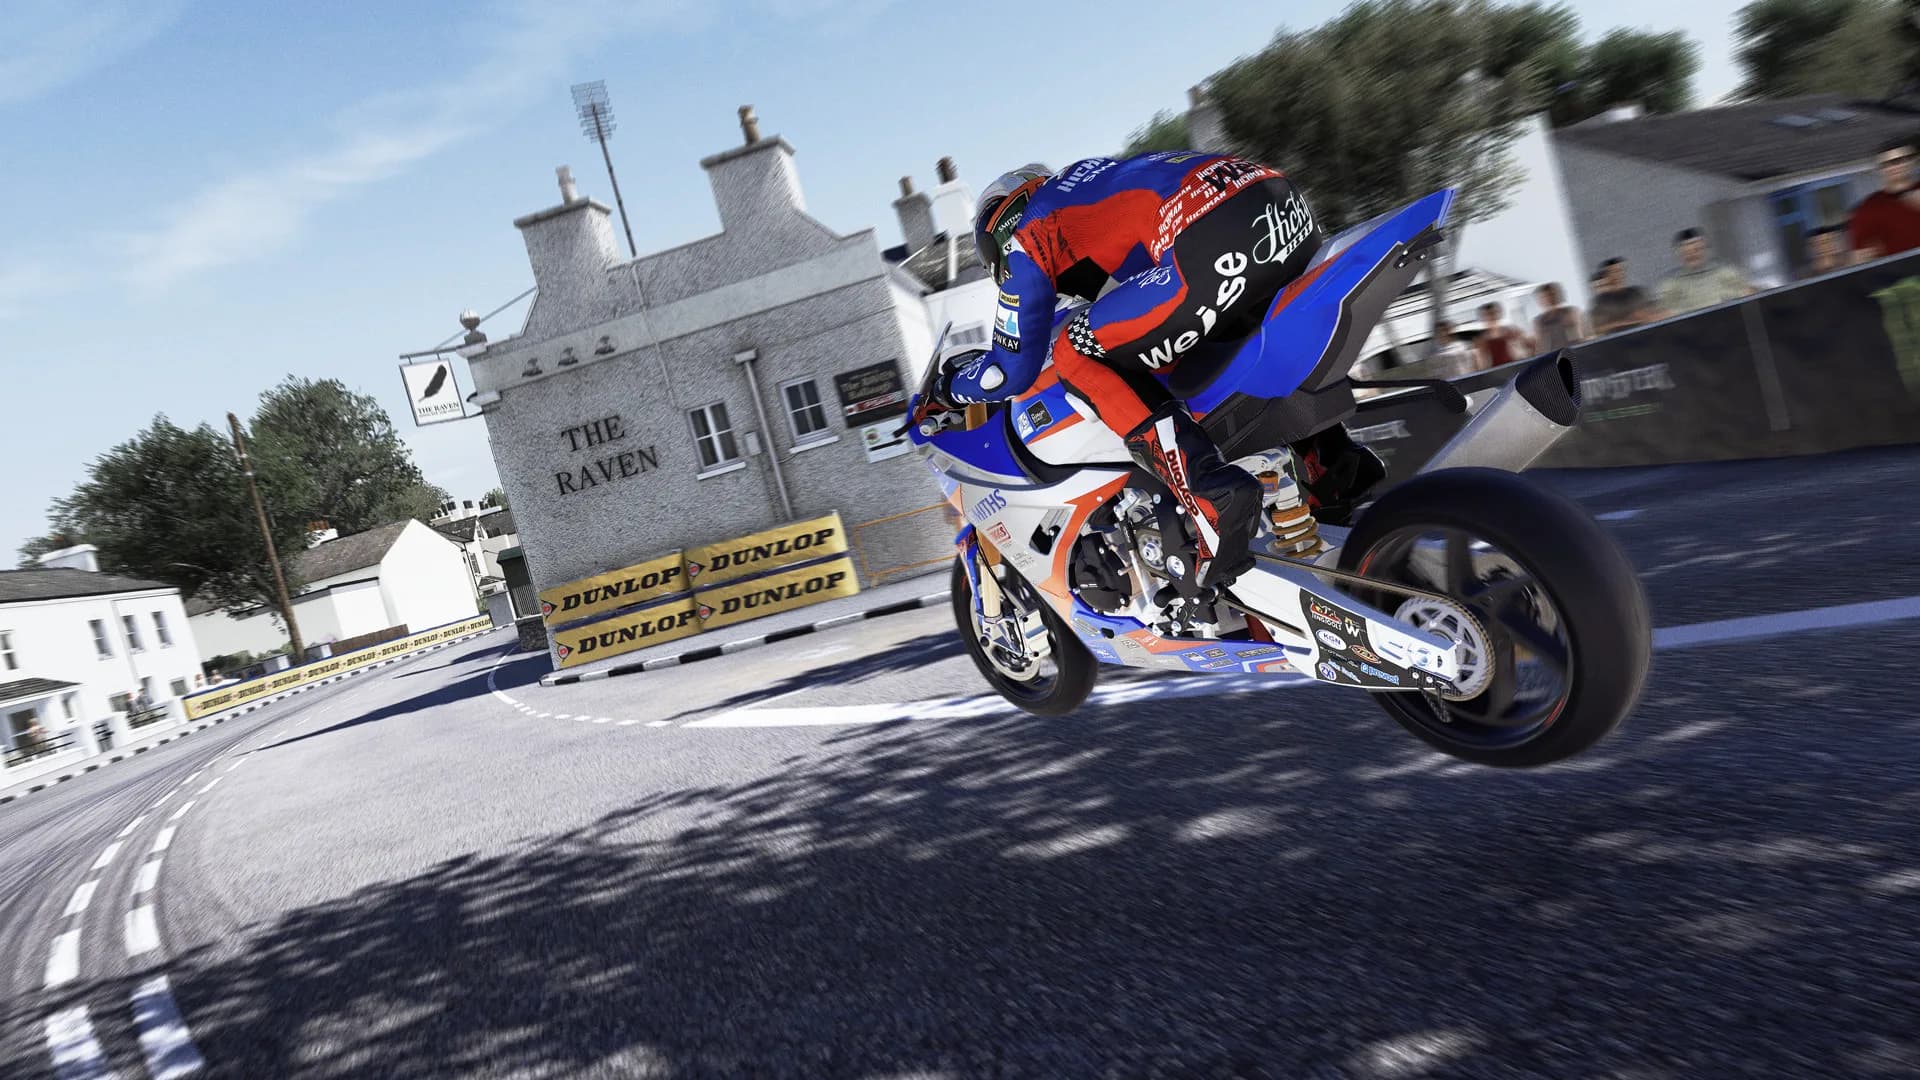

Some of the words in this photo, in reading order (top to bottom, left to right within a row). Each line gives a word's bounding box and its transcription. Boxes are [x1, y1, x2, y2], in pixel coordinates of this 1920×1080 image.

[561, 415, 625, 452] THE
[554, 445, 658, 496] RAVEN
[709, 527, 834, 572] DUNLOP
[561, 565, 681, 612] DUNLOP
[720, 571, 845, 615] DUNLOP
[347, 651, 376, 667] DUNLOP
[382, 641, 408, 656] DUNLOP
[414, 633, 438, 647] DUNLOP
[443, 626, 466, 638] DUNLOP
[577, 608, 697, 654] DUNLOP
